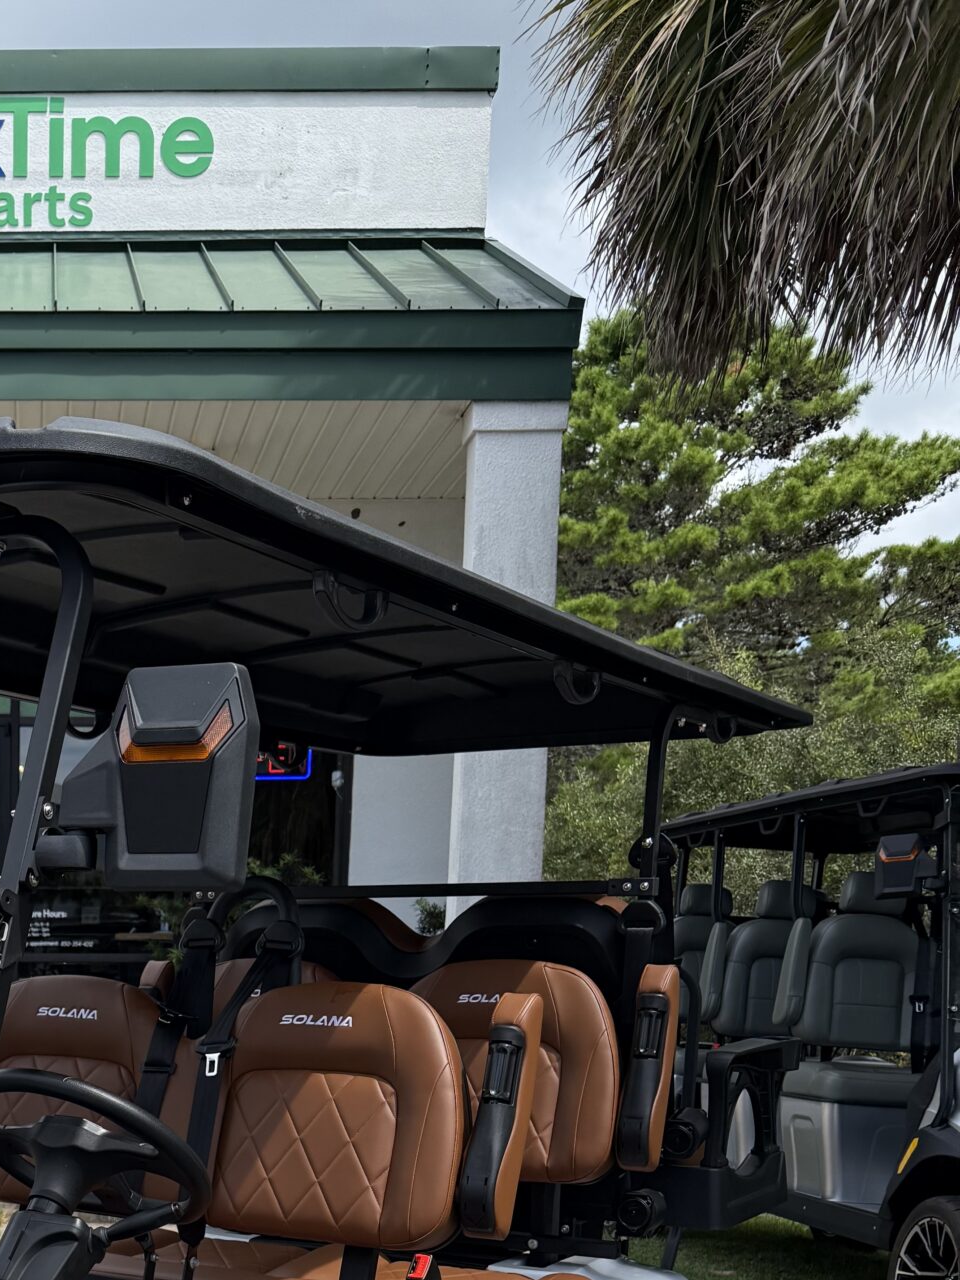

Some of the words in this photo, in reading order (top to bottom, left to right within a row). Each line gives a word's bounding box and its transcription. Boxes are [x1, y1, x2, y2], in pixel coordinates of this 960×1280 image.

[456, 993, 500, 1004] SOLA
[36, 1006, 98, 1020] SOLANA
[279, 1014, 353, 1028] SOLANA
